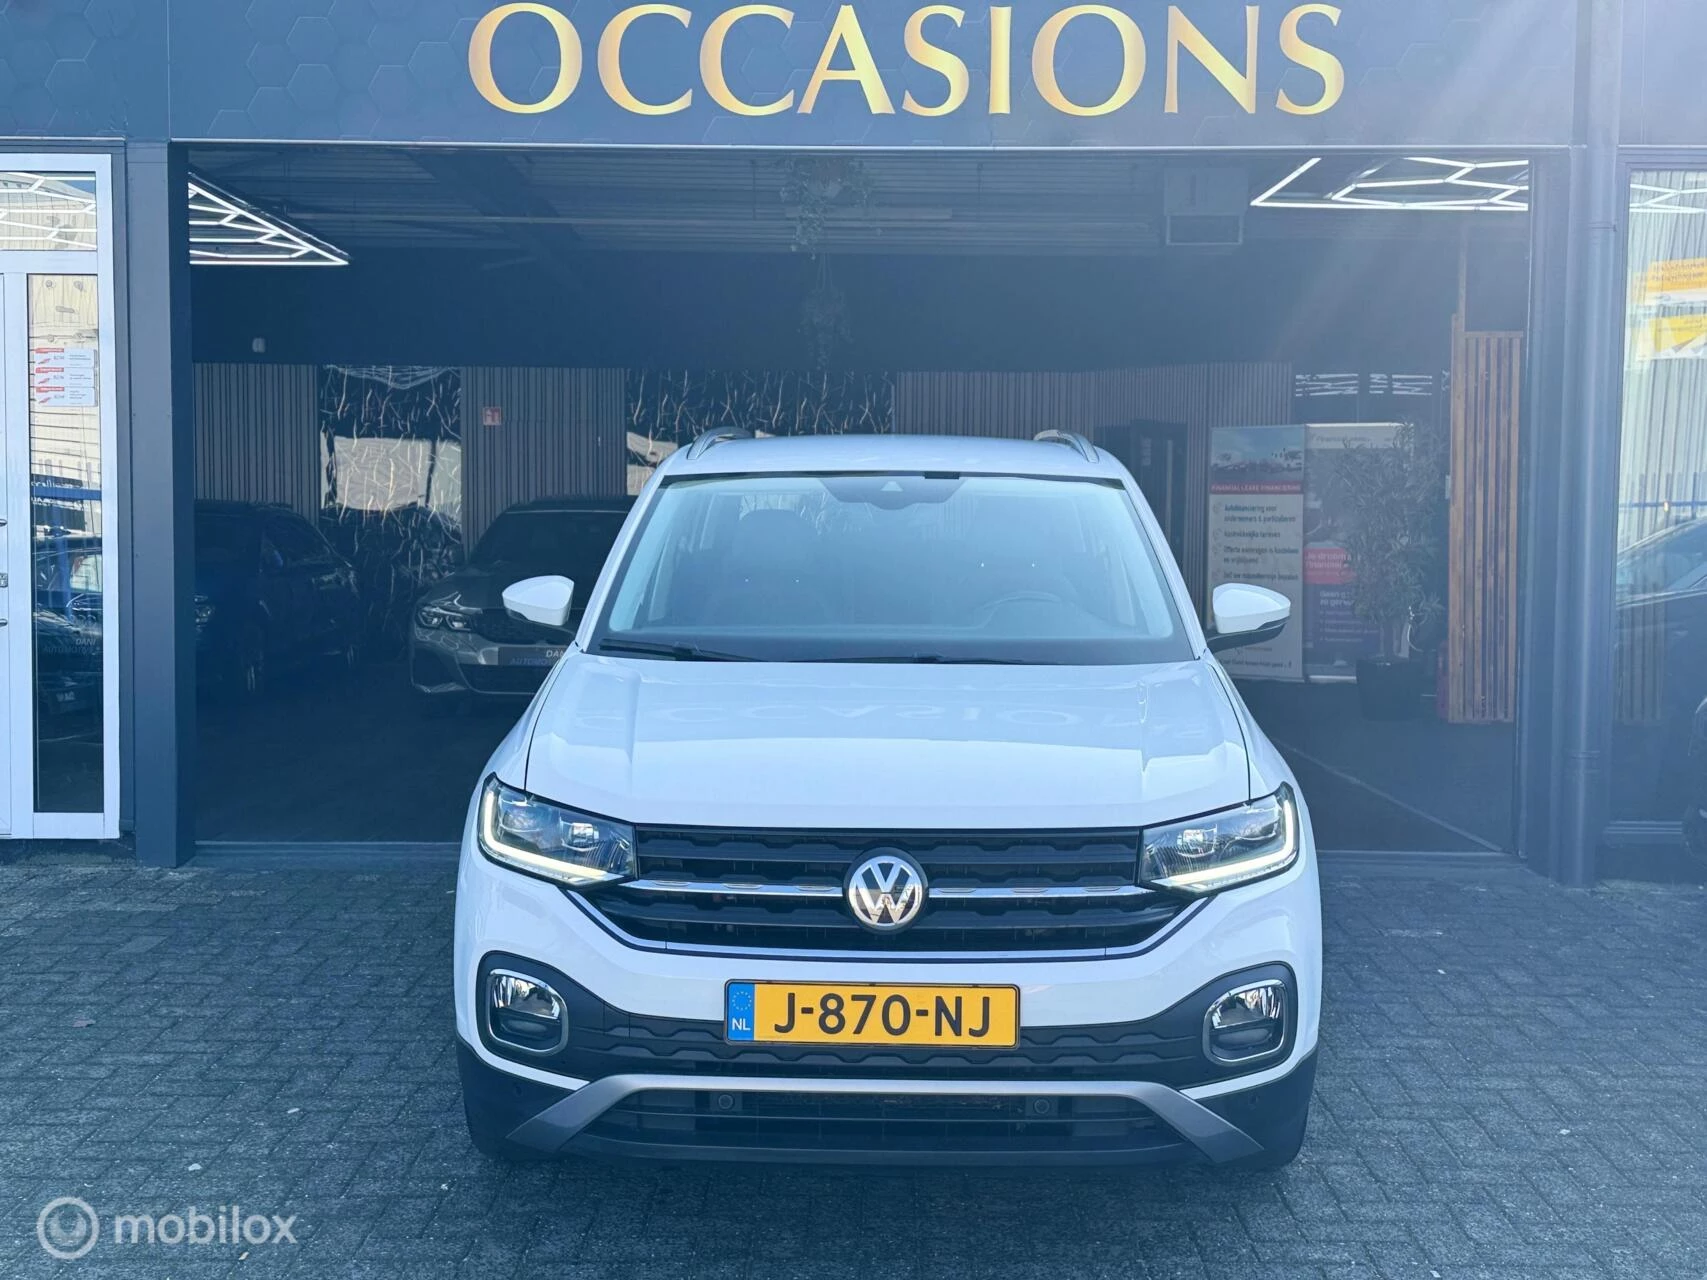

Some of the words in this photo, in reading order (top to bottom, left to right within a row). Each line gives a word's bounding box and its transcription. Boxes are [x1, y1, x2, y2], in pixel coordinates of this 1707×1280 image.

[468, 2, 1345, 116] OCCASIONS
[732, 1017, 751, 1031] NL
[773, 992, 991, 1038] J-870-NJ
